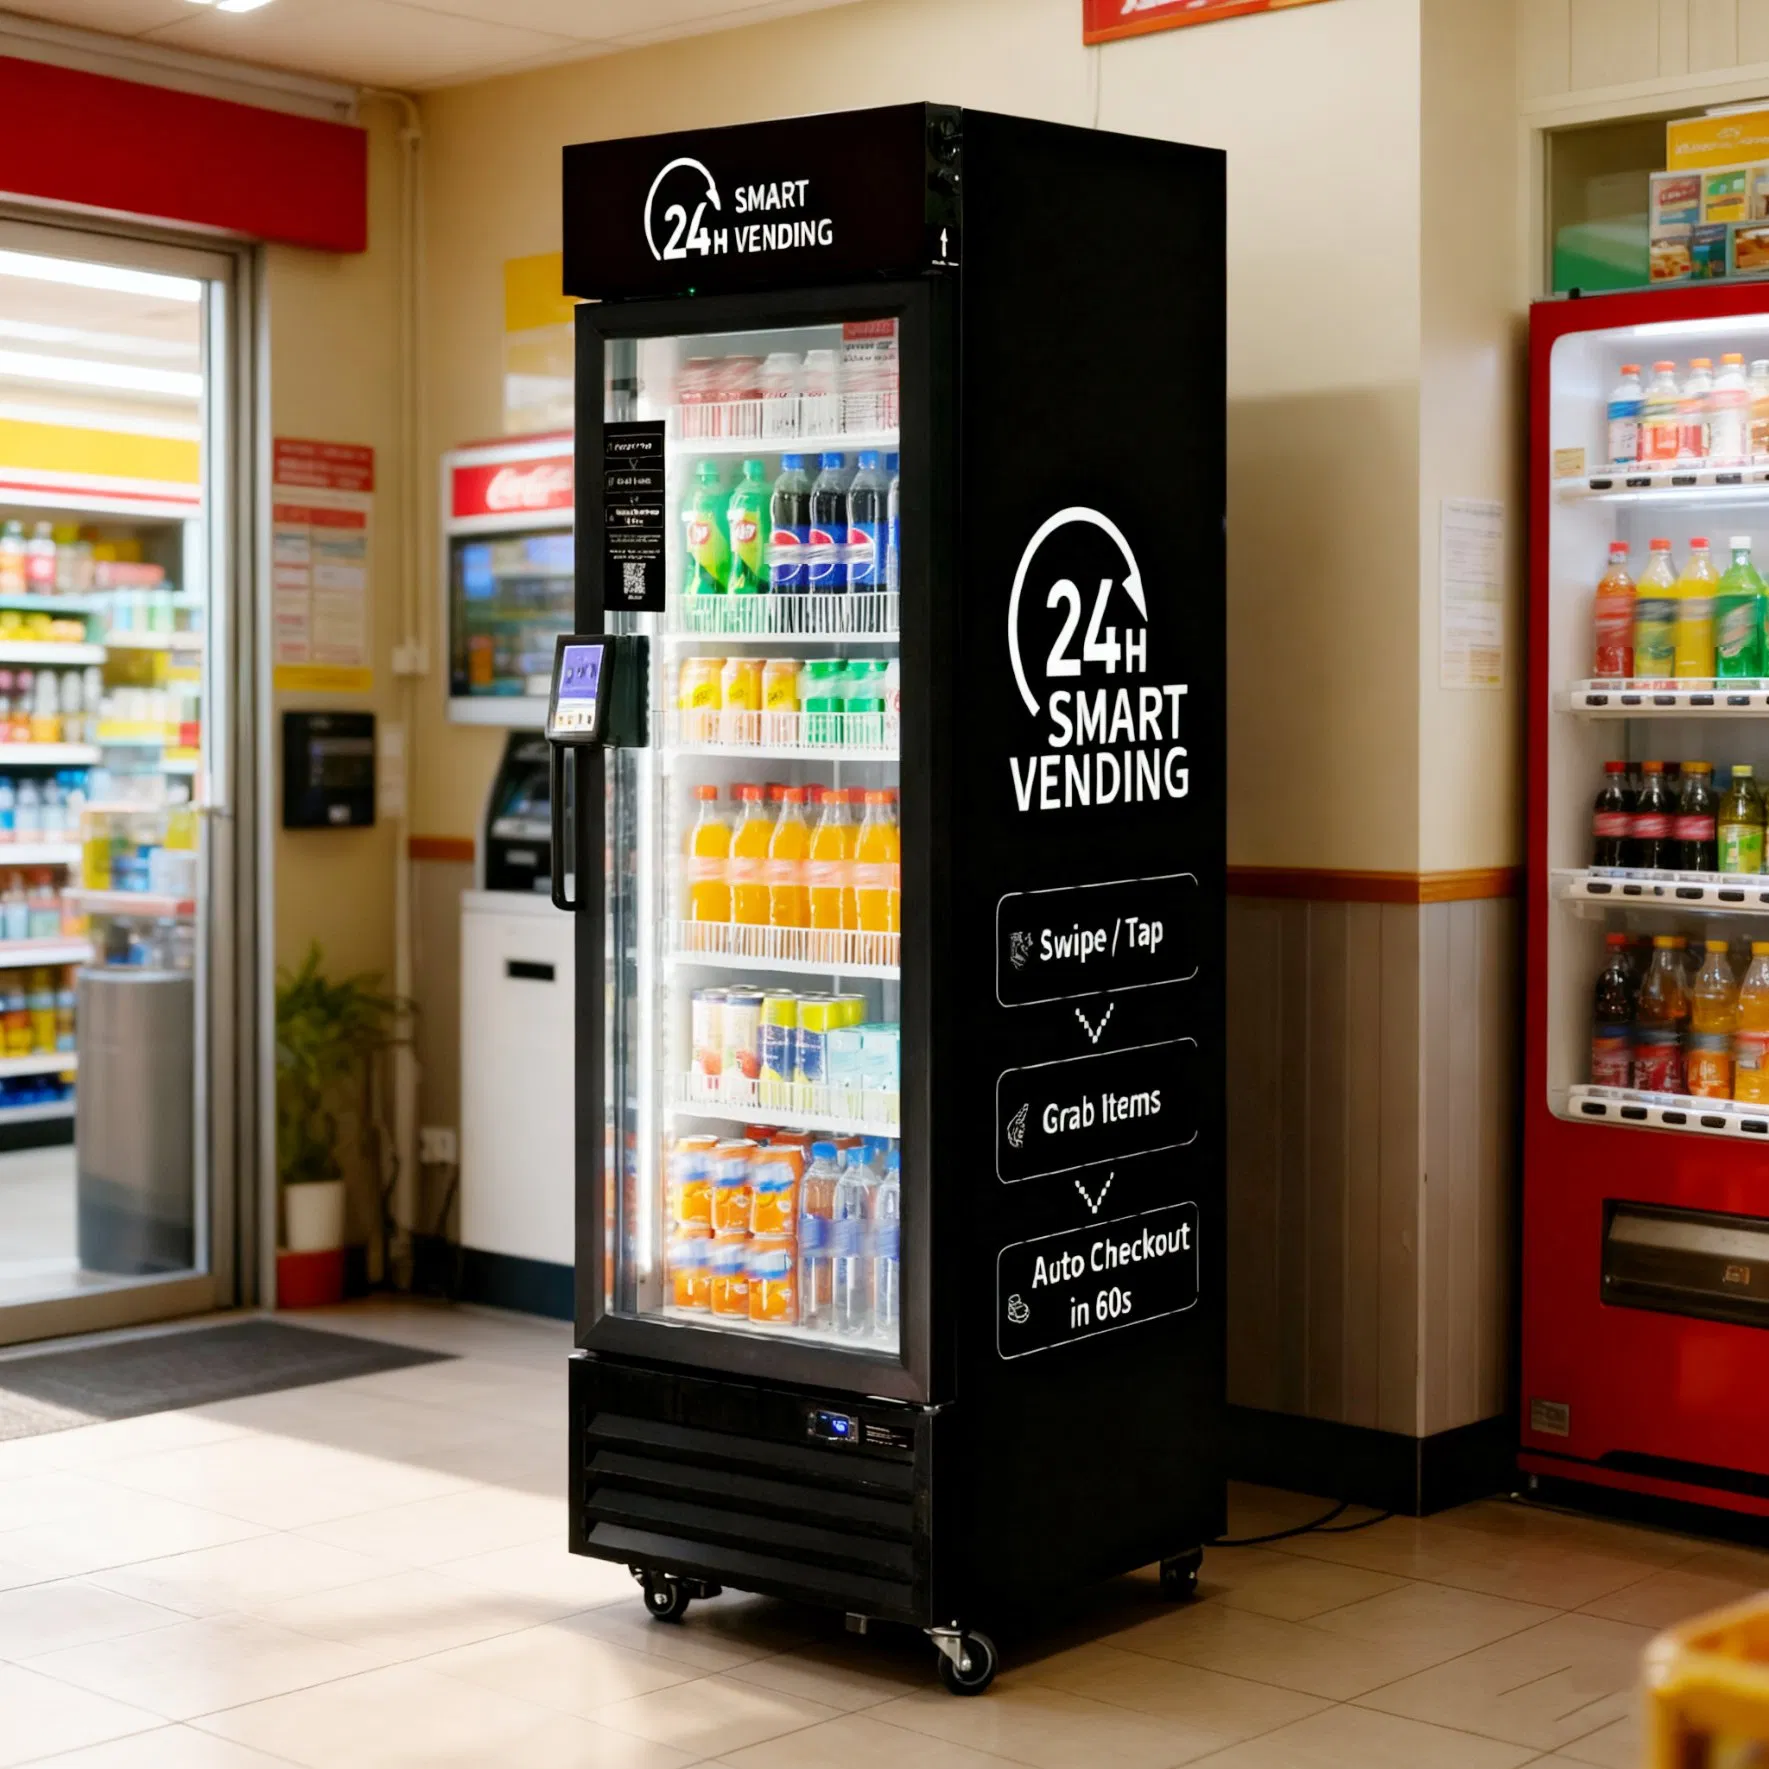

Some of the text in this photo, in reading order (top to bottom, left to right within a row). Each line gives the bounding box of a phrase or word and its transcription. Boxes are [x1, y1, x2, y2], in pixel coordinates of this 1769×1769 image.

[734, 179, 810, 214] SMART
[734, 218, 833, 253] VENDING
[1048, 683, 1188, 748] SMART
[1009, 746, 1189, 812] VENDING
[1040, 917, 1164, 963] Swipe / Tap
[1042, 1088, 1162, 1134] Grab Items
[1032, 1222, 1191, 1289] Auto Checkout
[1070, 1286, 1132, 1329] in 60s
